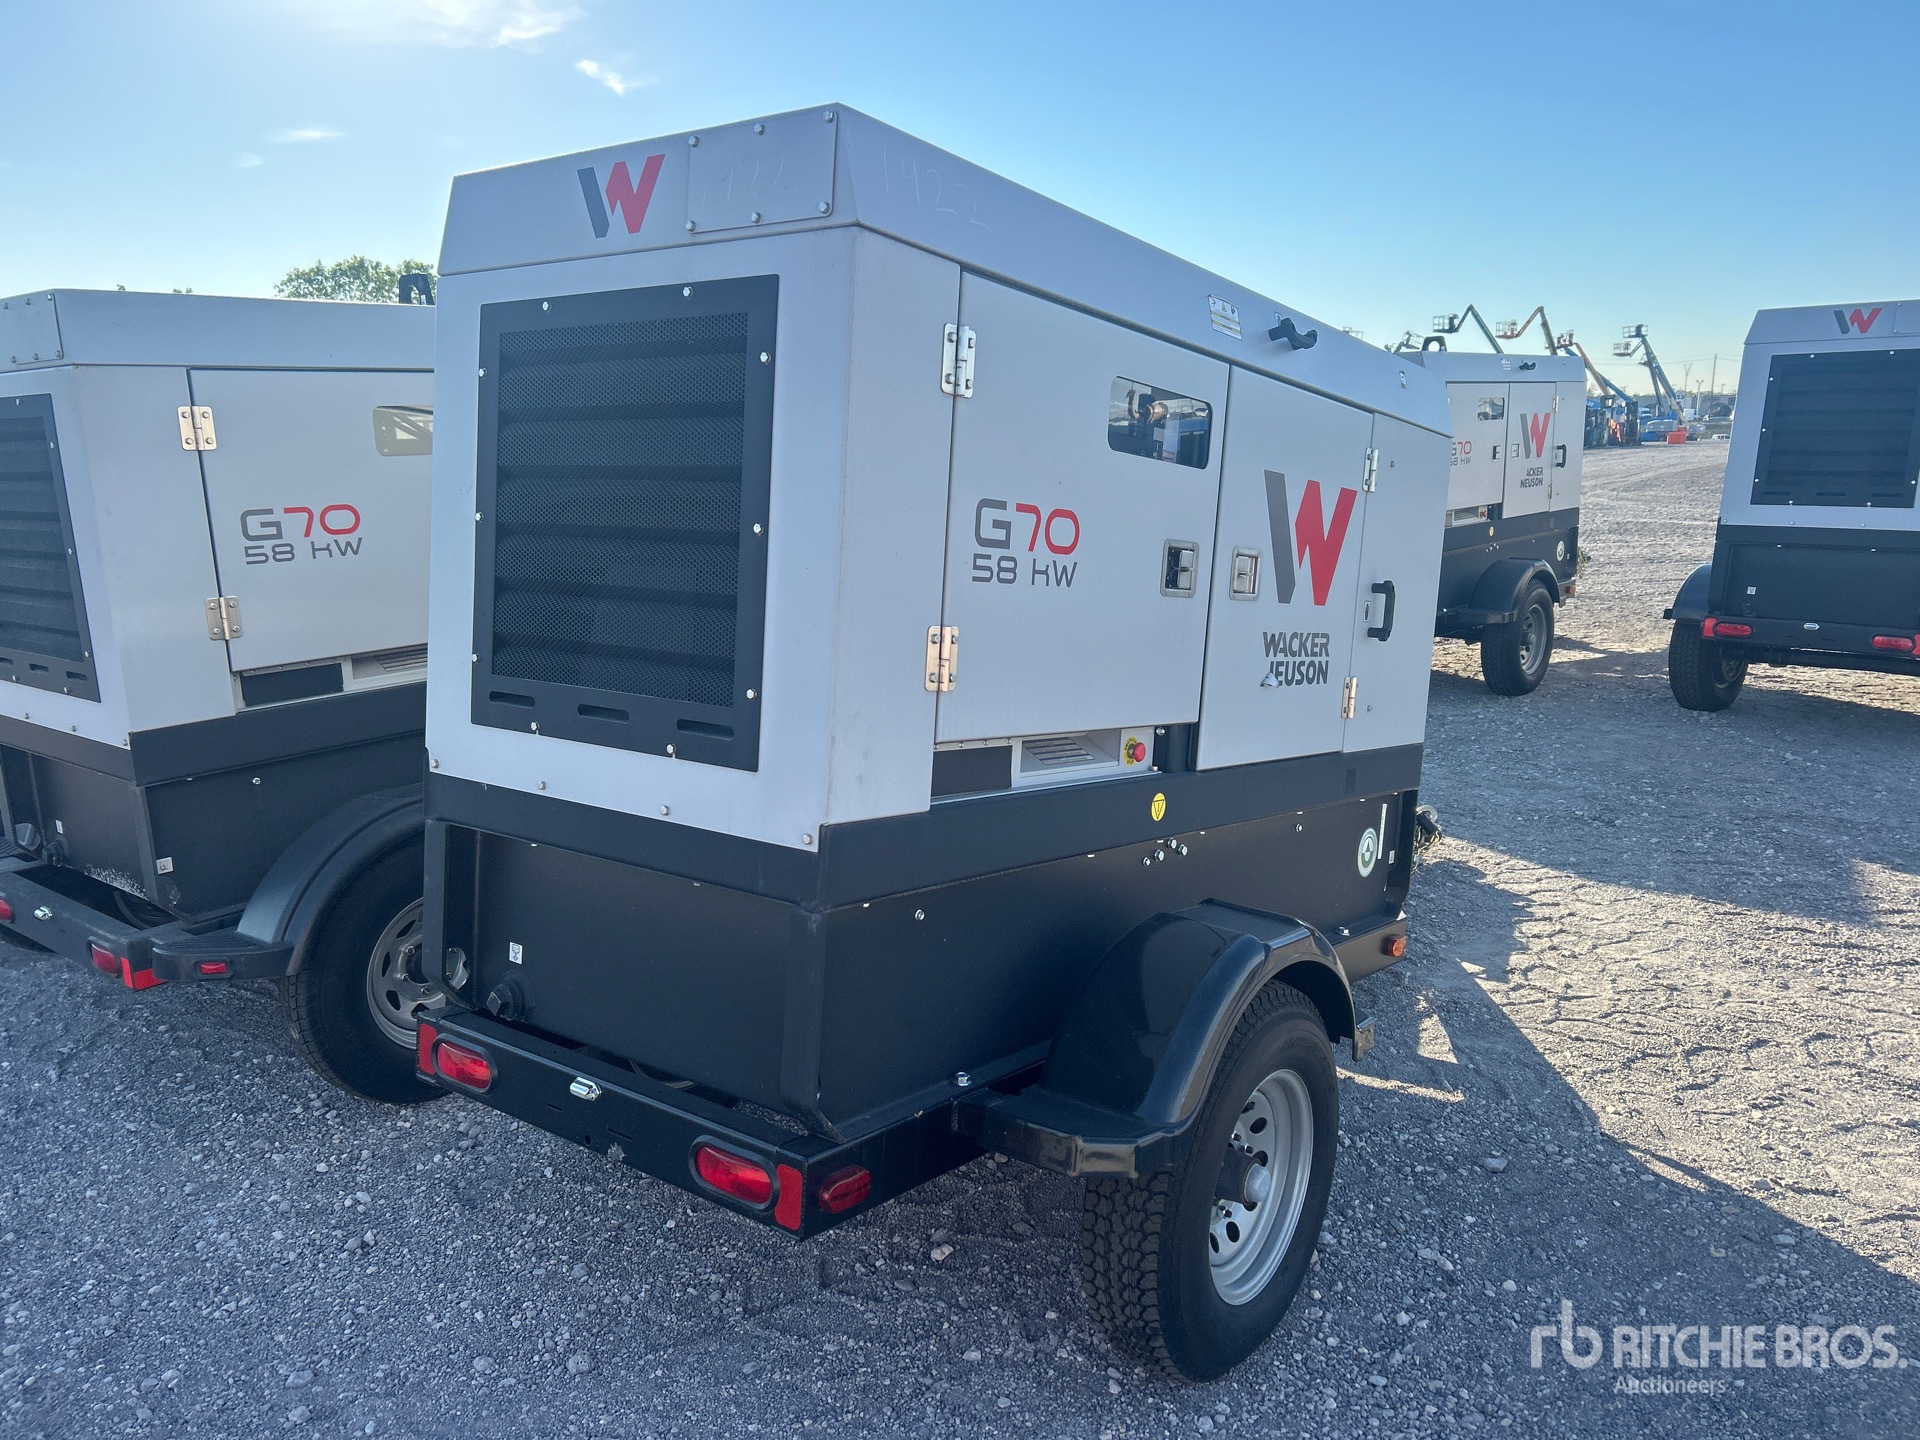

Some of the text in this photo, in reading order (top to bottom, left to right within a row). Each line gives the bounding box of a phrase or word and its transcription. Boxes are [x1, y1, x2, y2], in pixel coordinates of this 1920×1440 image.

[577, 154, 666, 238] W
[881, 143, 994, 233] 1922
[1833, 307, 1883, 334] W
[1520, 412, 1551, 459] W
[1520, 477, 1544, 489] NEUSON
[240, 503, 361, 542] G70
[974, 498, 1080, 555] G70
[1264, 469, 1358, 606] W
[244, 542, 296, 565] 58
[972, 553, 1018, 585] 58
[1263, 631, 1330, 658] WACKER
